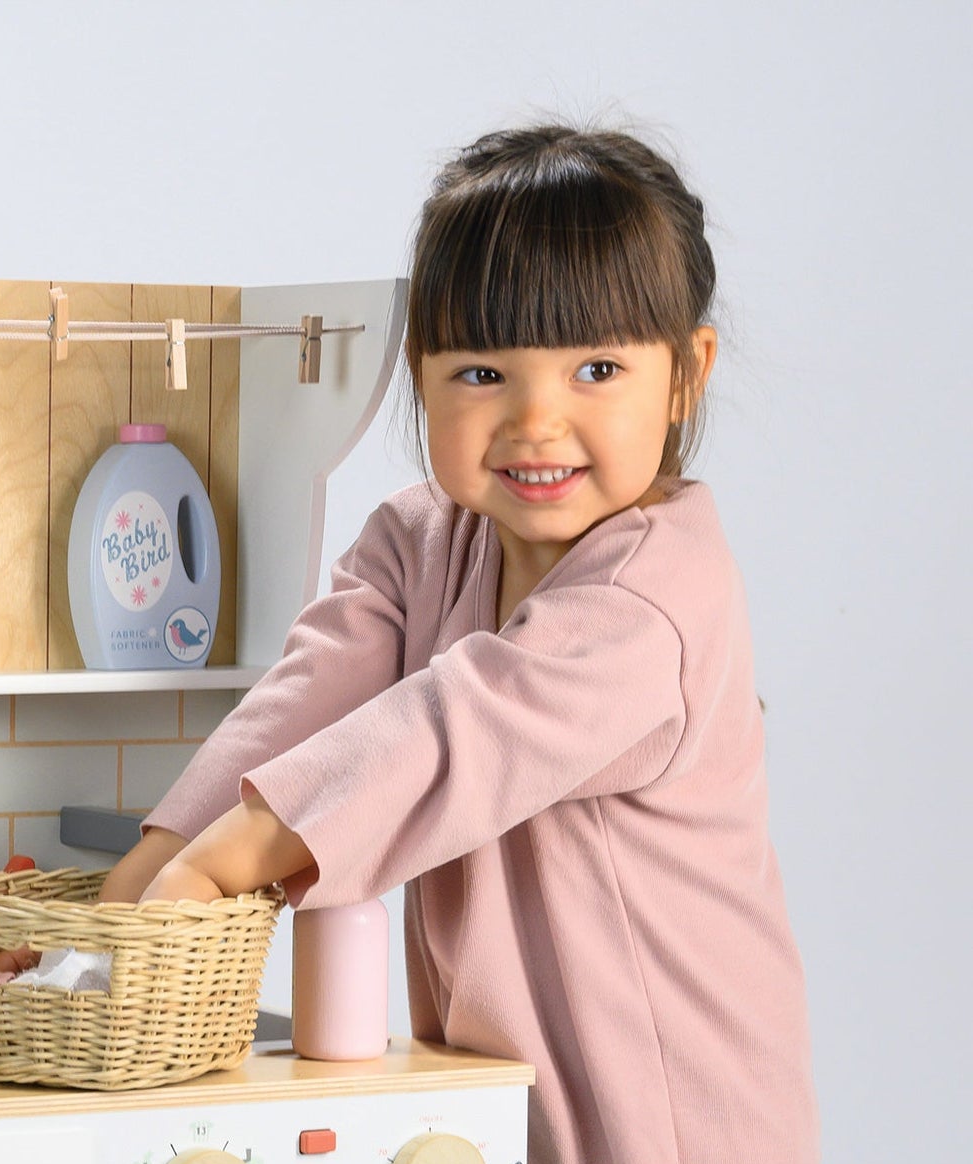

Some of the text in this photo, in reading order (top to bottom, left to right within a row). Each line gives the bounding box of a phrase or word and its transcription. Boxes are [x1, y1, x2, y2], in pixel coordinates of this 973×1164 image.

[101, 517, 158, 563] Baby
[120, 532, 171, 583] Bird
[110, 630, 146, 639] FABRIC
[110, 640, 160, 651] SOFTENER
